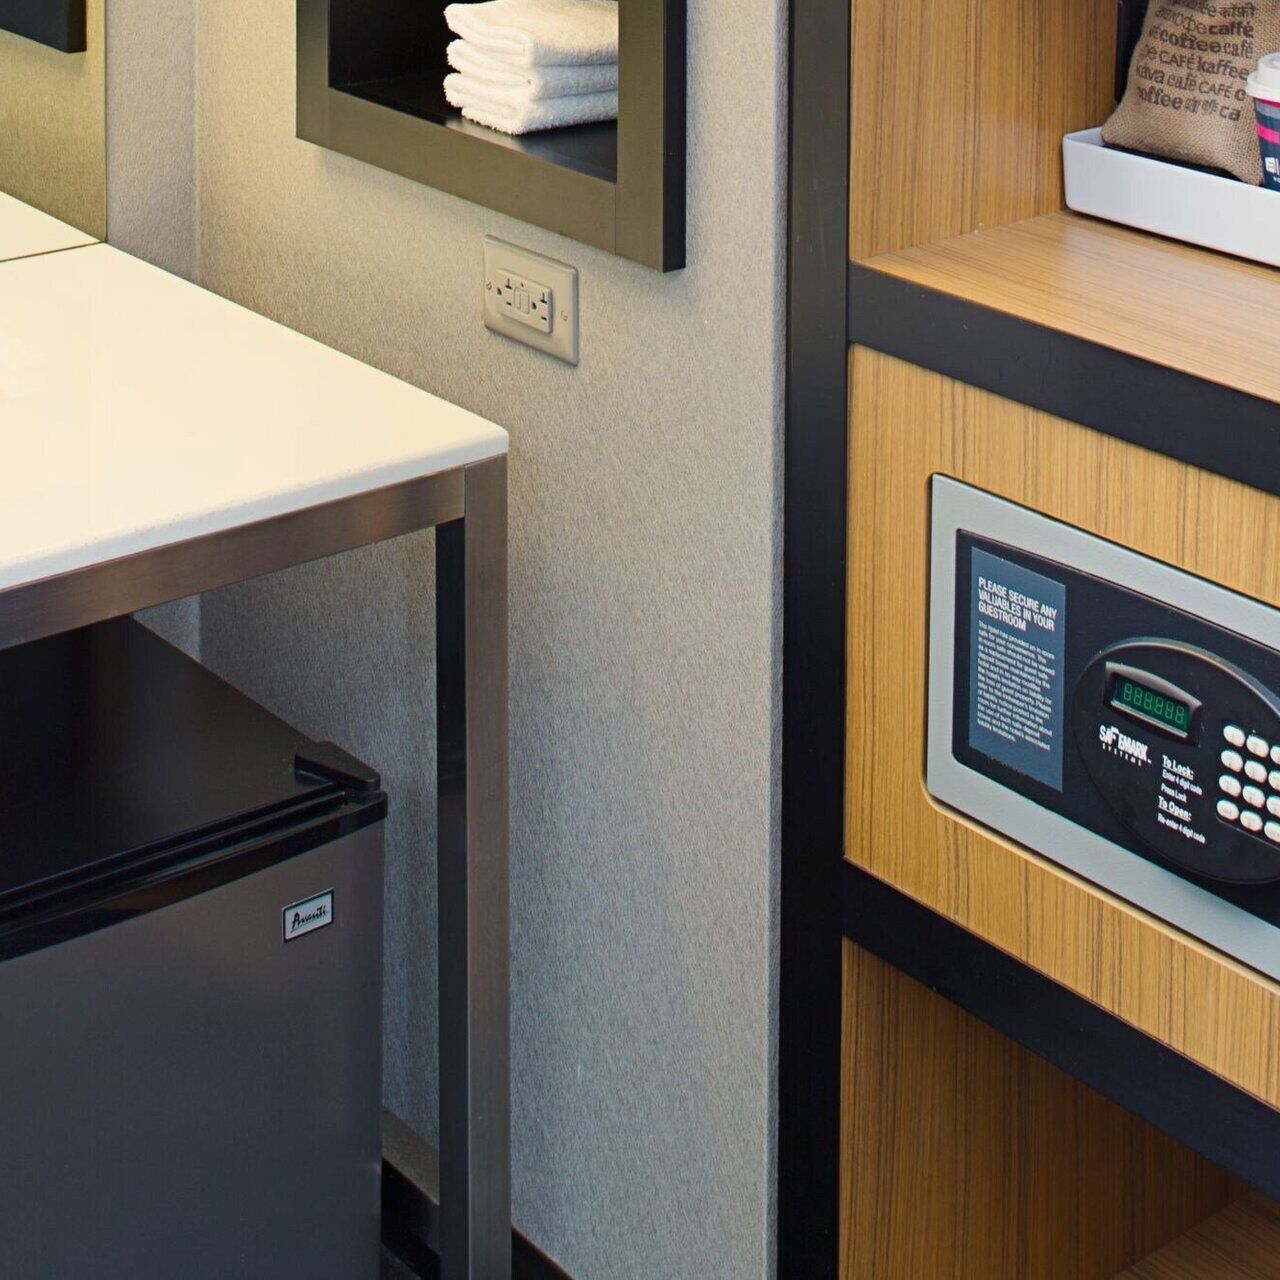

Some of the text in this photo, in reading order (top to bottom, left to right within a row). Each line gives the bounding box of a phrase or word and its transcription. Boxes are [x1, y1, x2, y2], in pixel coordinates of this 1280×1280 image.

[1160, 29, 1222, 53] coffee
[1197, 56, 1250, 80] kaffee
[978, 576, 1057, 620] PLEASE SECURE ANY
[978, 588, 1055, 632] VALUABLES IN YOUR
[978, 601, 1027, 632] GUESTROOM
[1099, 724, 1148, 762] SAFEMARK
[1102, 742, 1142, 767] SYSTEMS
[1162, 754, 1194, 778] To Lock:
[1161, 782, 1187, 803] Press Lock
[1162, 769, 1176, 782] Enter
[1190, 784, 1202, 796] code
[1158, 795, 1192, 821] To Open:
[1194, 832, 1206, 845] code
[291, 905, 328, 933] Avanti
